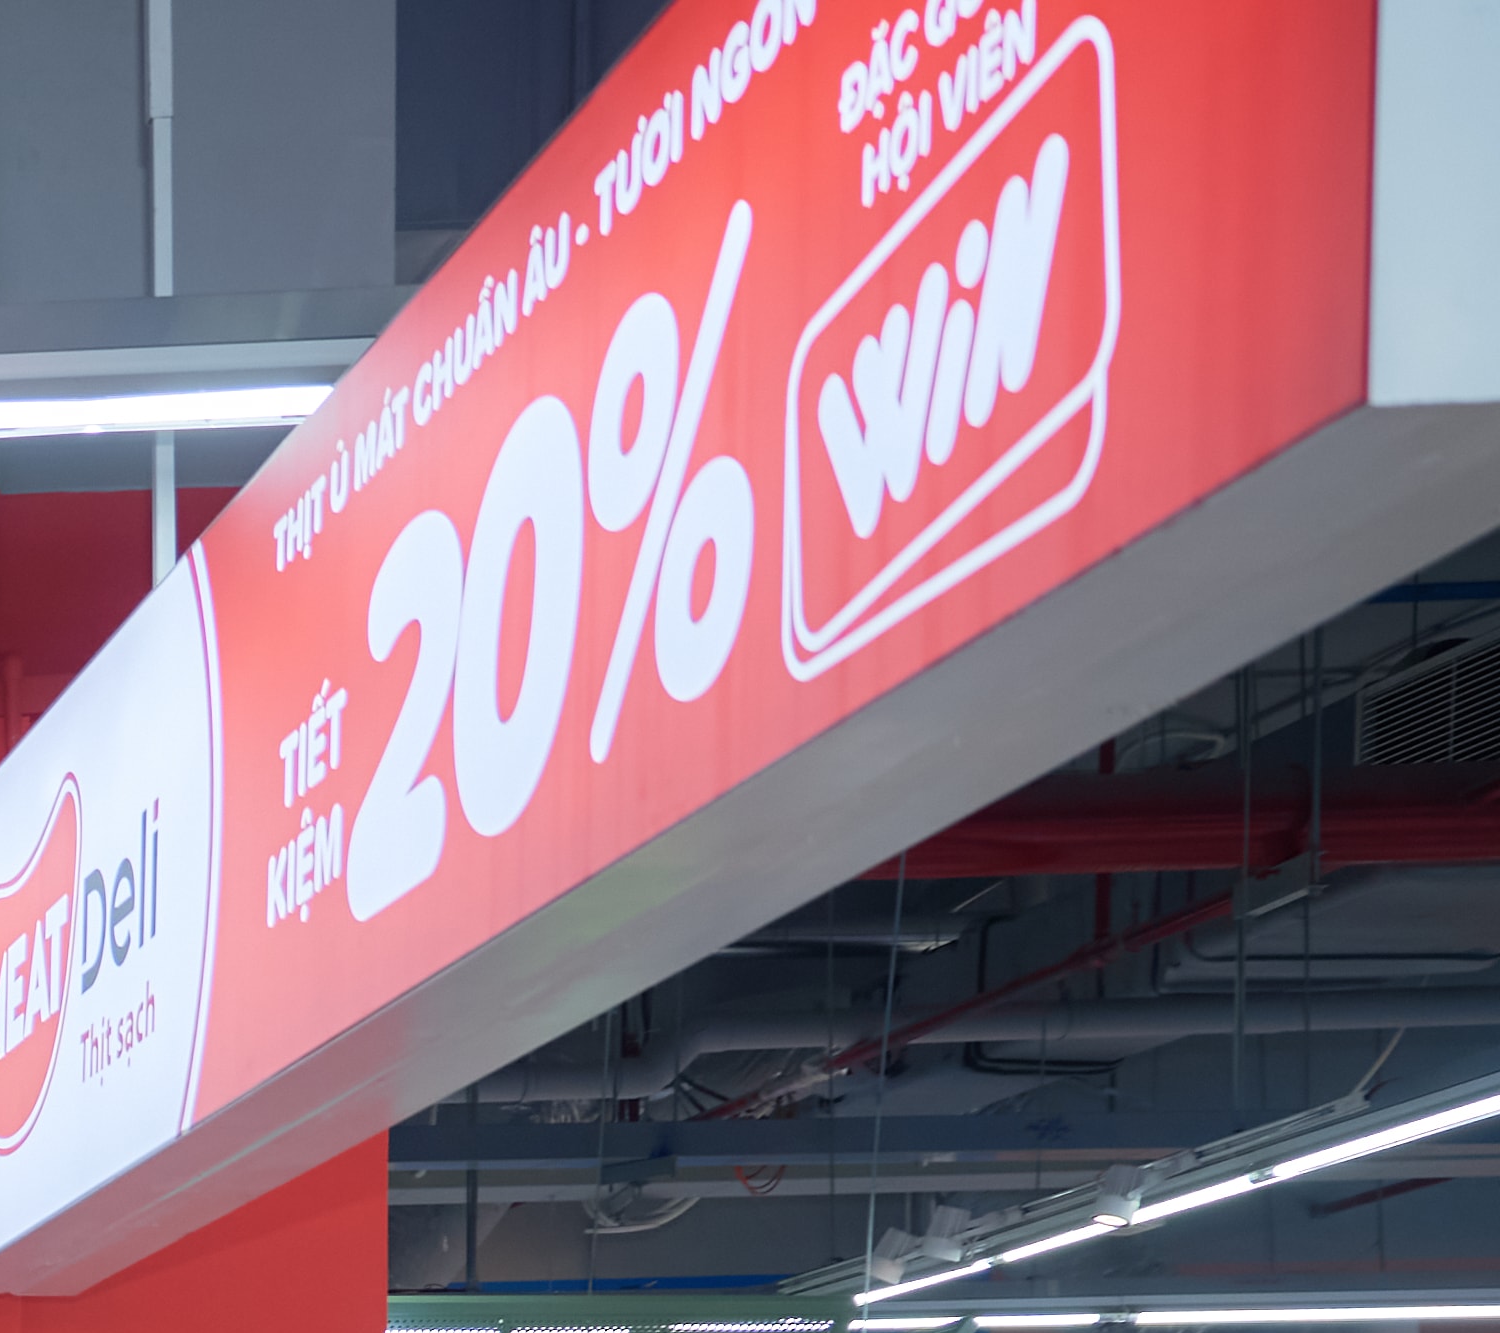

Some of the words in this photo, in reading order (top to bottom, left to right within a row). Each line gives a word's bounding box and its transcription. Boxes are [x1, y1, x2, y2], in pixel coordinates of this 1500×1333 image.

[838, 9, 919, 133] ĐẶC
[861, 89, 933, 208] HỘI
[938, 0, 1037, 132] VIÊN
[274, 475, 325, 571] THỊT
[330, 440, 349, 513] Ủ
[353, 385, 410, 491] MÁT
[413, 275, 518, 426] CHUẨN
[522, 212, 571, 317] ÂU
[595, 90, 683, 236] TƯƠI
[346, 200, 754, 922] 20%
[279, 679, 346, 808] TIẾT
[81, 800, 160, 995] Deli
[266, 800, 344, 928] KIỆM
[80, 1015, 115, 1085] Thịt
[117, 979, 158, 1069] sạch
